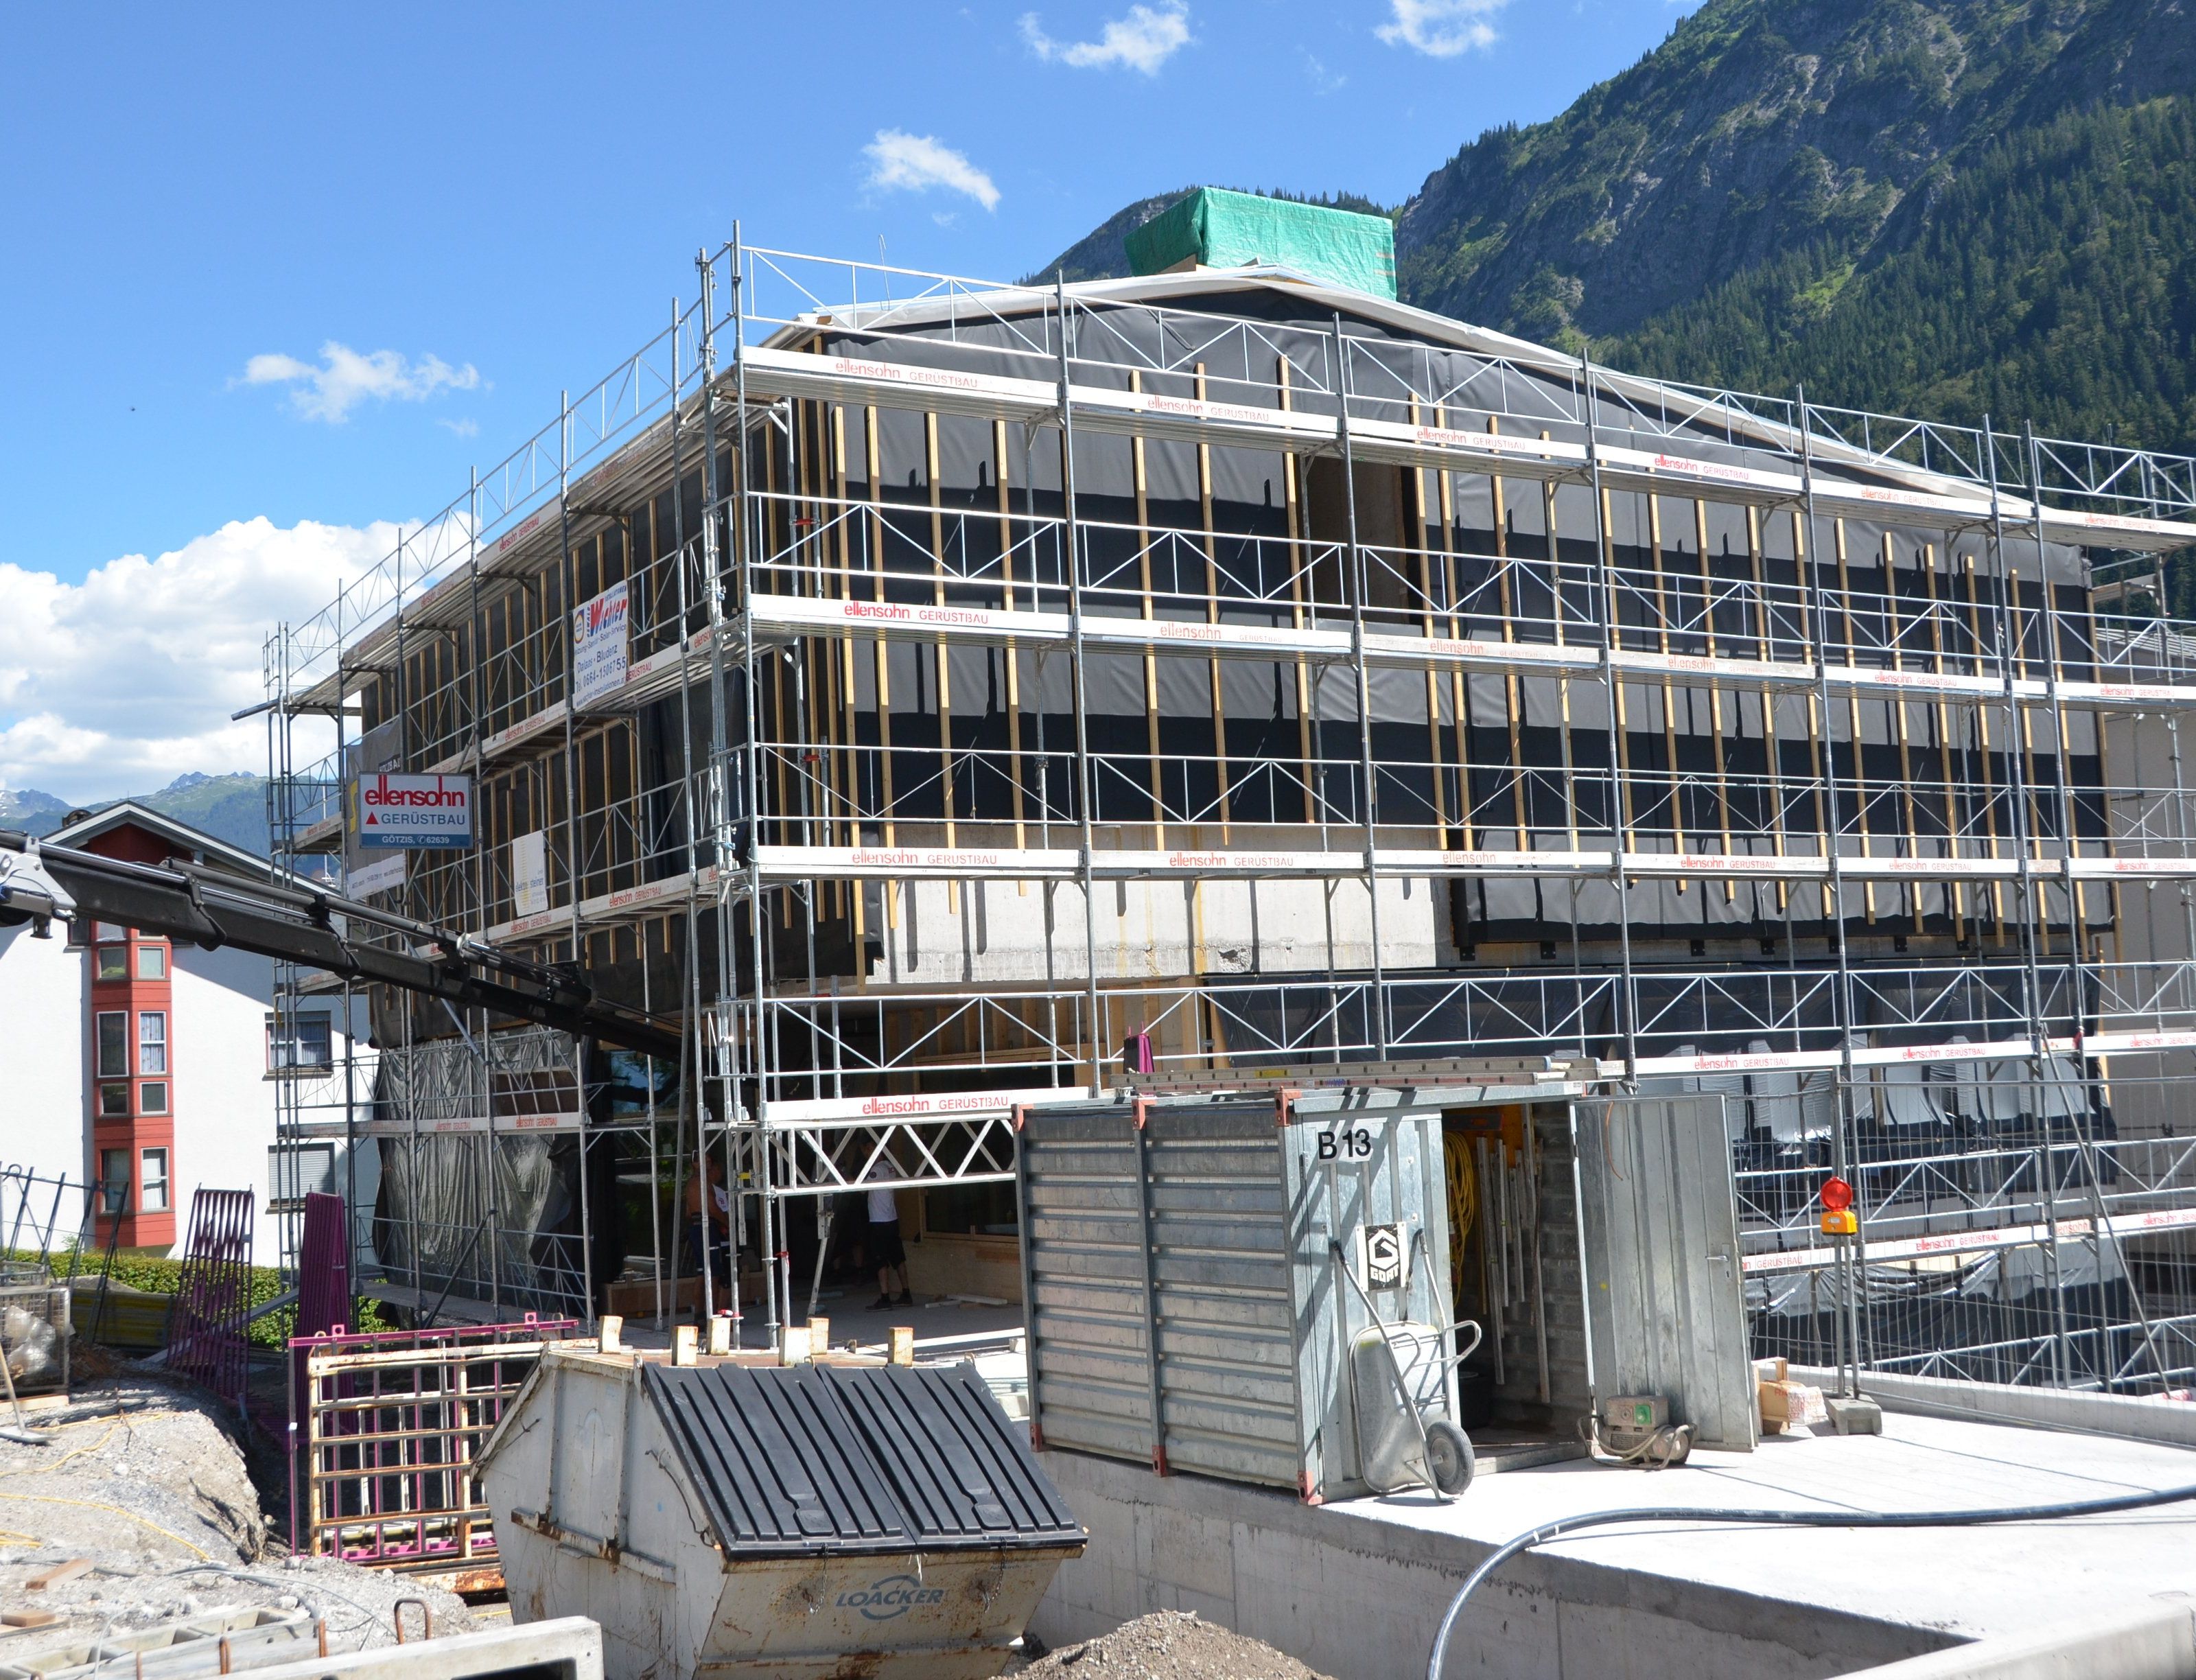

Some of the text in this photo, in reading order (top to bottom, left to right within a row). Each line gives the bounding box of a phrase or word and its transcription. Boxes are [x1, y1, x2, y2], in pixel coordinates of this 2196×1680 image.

[835, 358, 978, 388] ellensohn GERÜSTBAU
[1147, 395, 1203, 414] ellensohn
[1417, 427, 1467, 444] ellensohn
[1655, 453, 1698, 472] ellensohn
[1861, 485, 1899, 502] ellensohn
[844, 600, 988, 625] ellensohn GERÜSTBAU
[1160, 622, 1222, 640] ellensohn
[1429, 640, 1484, 655] ellensohn
[1668, 654, 1716, 671] ellensohn
[1875, 670, 1913, 684] ellensohn
[364, 774, 465, 807] ellensohn
[381, 811, 465, 825] GERÜSTBAU
[382, 836, 449, 844] GÖTZIS, 62639
[852, 849, 918, 864] ellensohn
[1169, 852, 1226, 867] ellensohn
[1442, 851, 1497, 864] ellensohn
[1681, 856, 1725, 868] ellensohn
[1889, 857, 1927, 871] ellensohn
[609, 889, 632, 907] ellensohn
[1902, 1045, 1941, 1060] ellensohn
[1694, 1056, 1738, 1071] ellensohn
[862, 1096, 1009, 1115] ellensohn GERÜSTBAU
[1318, 1128, 1372, 1160] B 13
[1915, 1237, 1955, 1252] ellensohn
[835, 1589, 944, 1607] LOACKER
